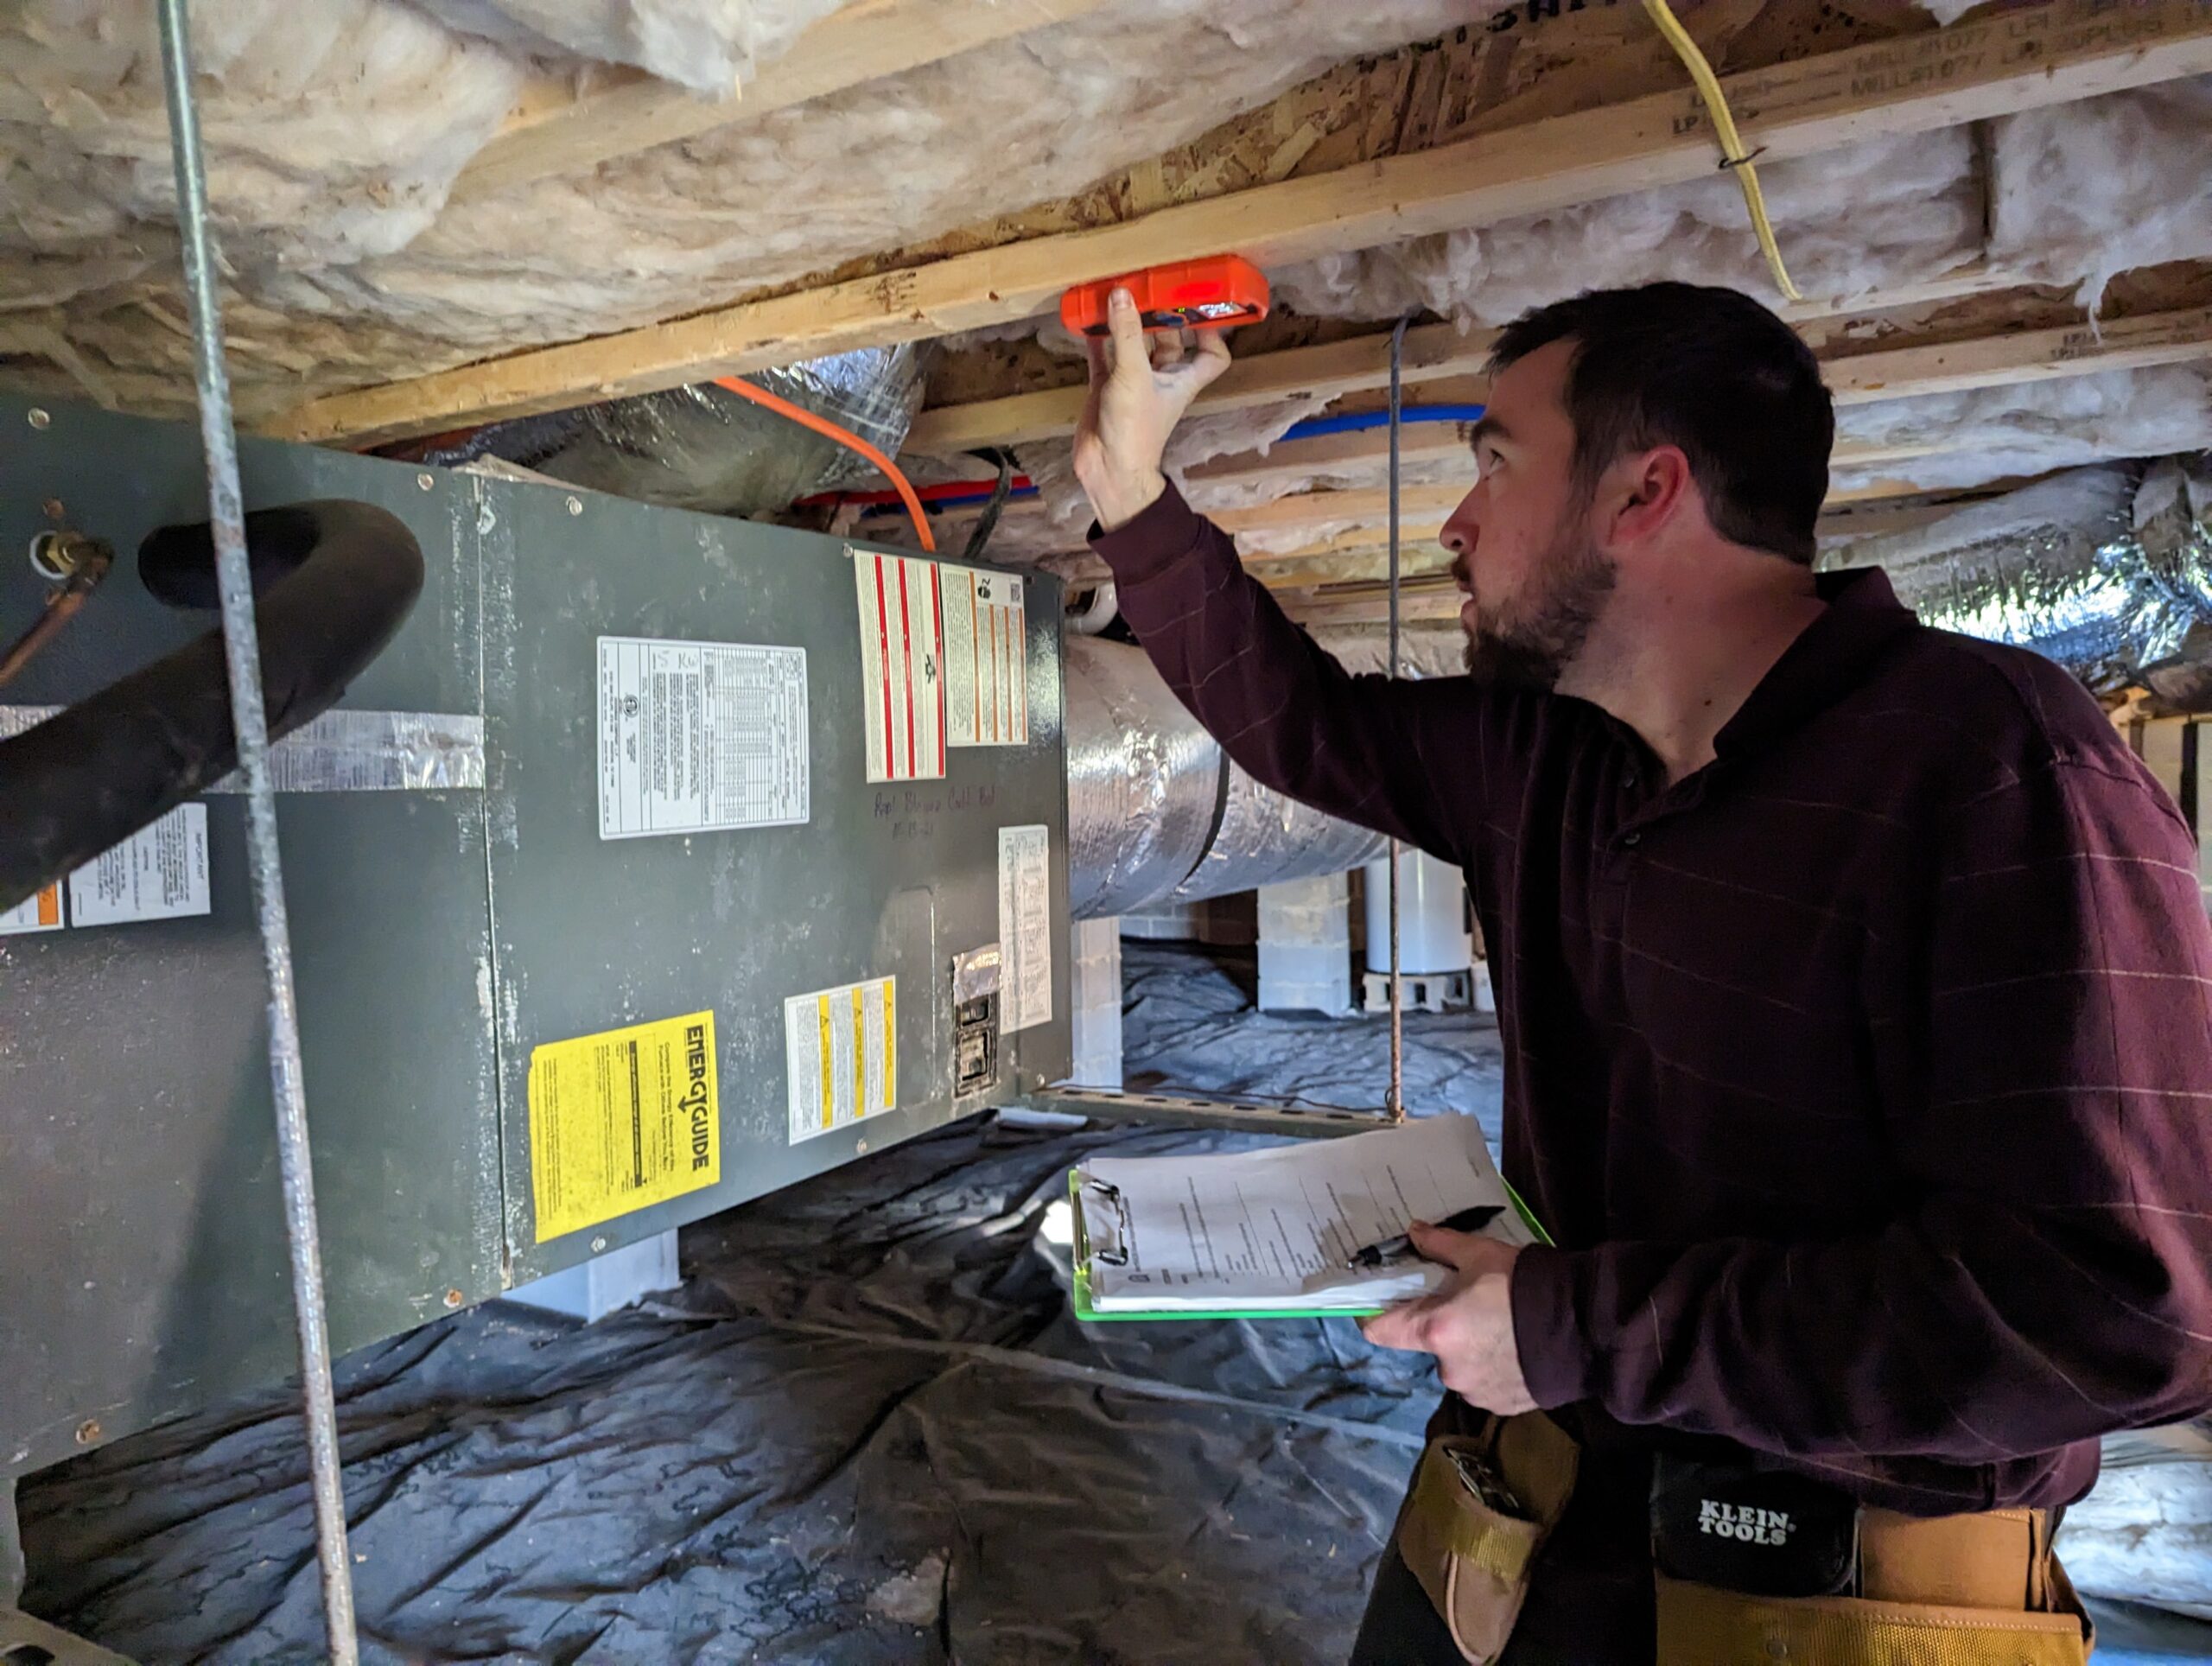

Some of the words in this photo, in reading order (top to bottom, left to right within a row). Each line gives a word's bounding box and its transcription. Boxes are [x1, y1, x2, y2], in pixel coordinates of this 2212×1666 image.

[684, 1025, 709, 1172] ENERGYGUIDE
[1700, 1499, 1789, 1529] KLEIN
[1698, 1516, 1786, 1546] TOOLS
